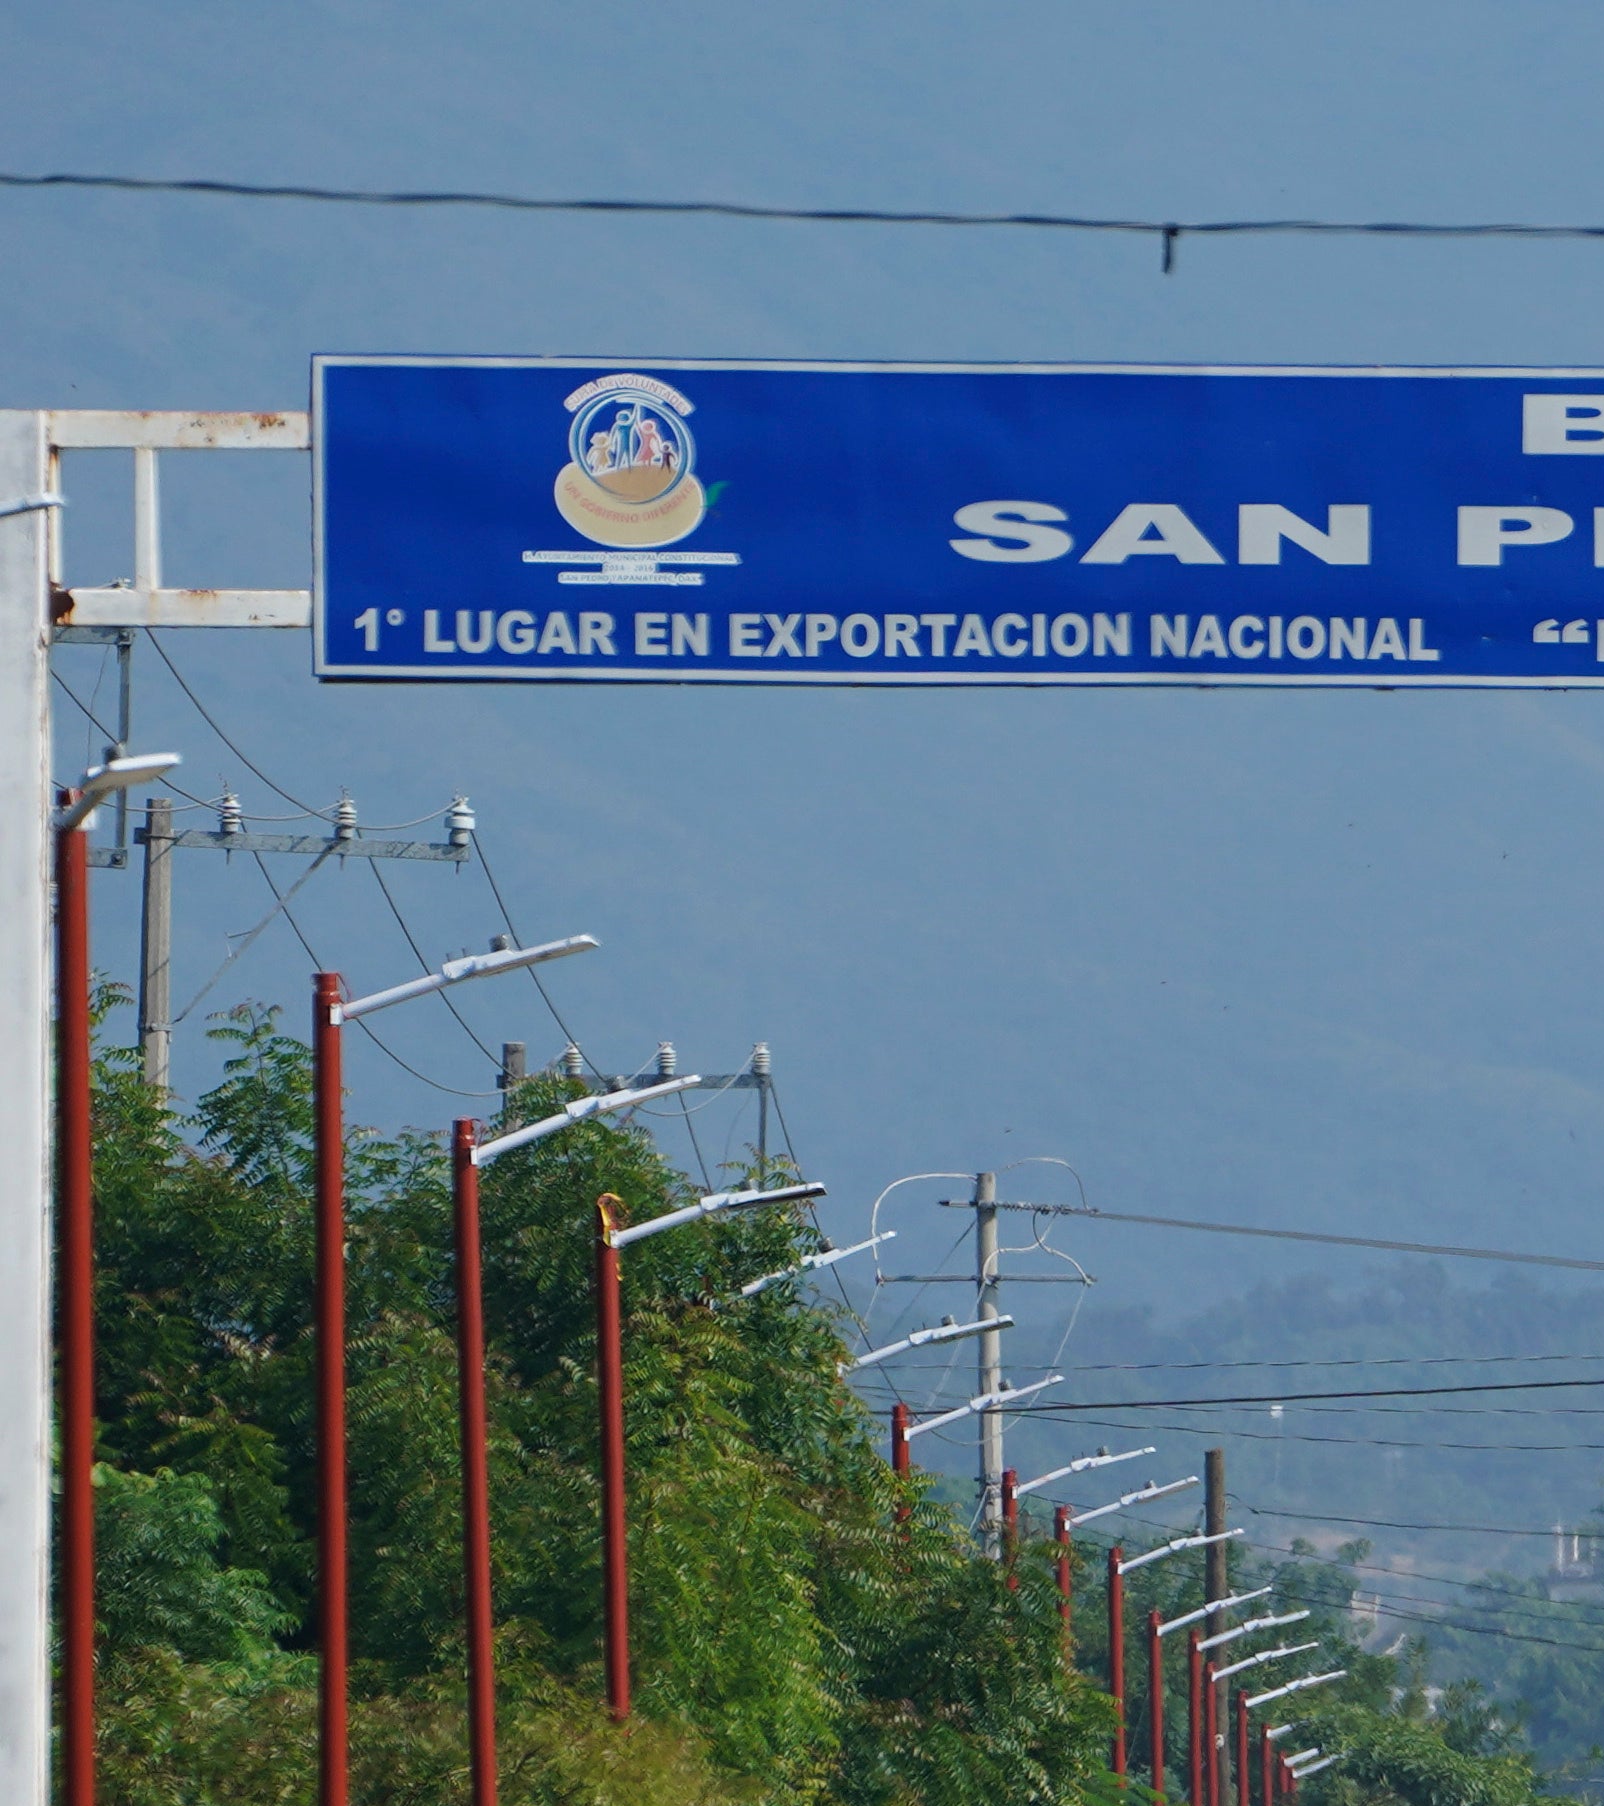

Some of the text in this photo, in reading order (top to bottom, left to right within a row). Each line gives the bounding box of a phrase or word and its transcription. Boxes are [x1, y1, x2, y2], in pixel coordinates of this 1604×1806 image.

[950, 501, 1369, 564] SAN
[355, 608, 1438, 660] 1° LUGAR EN EXPORTACION NACIONAL
